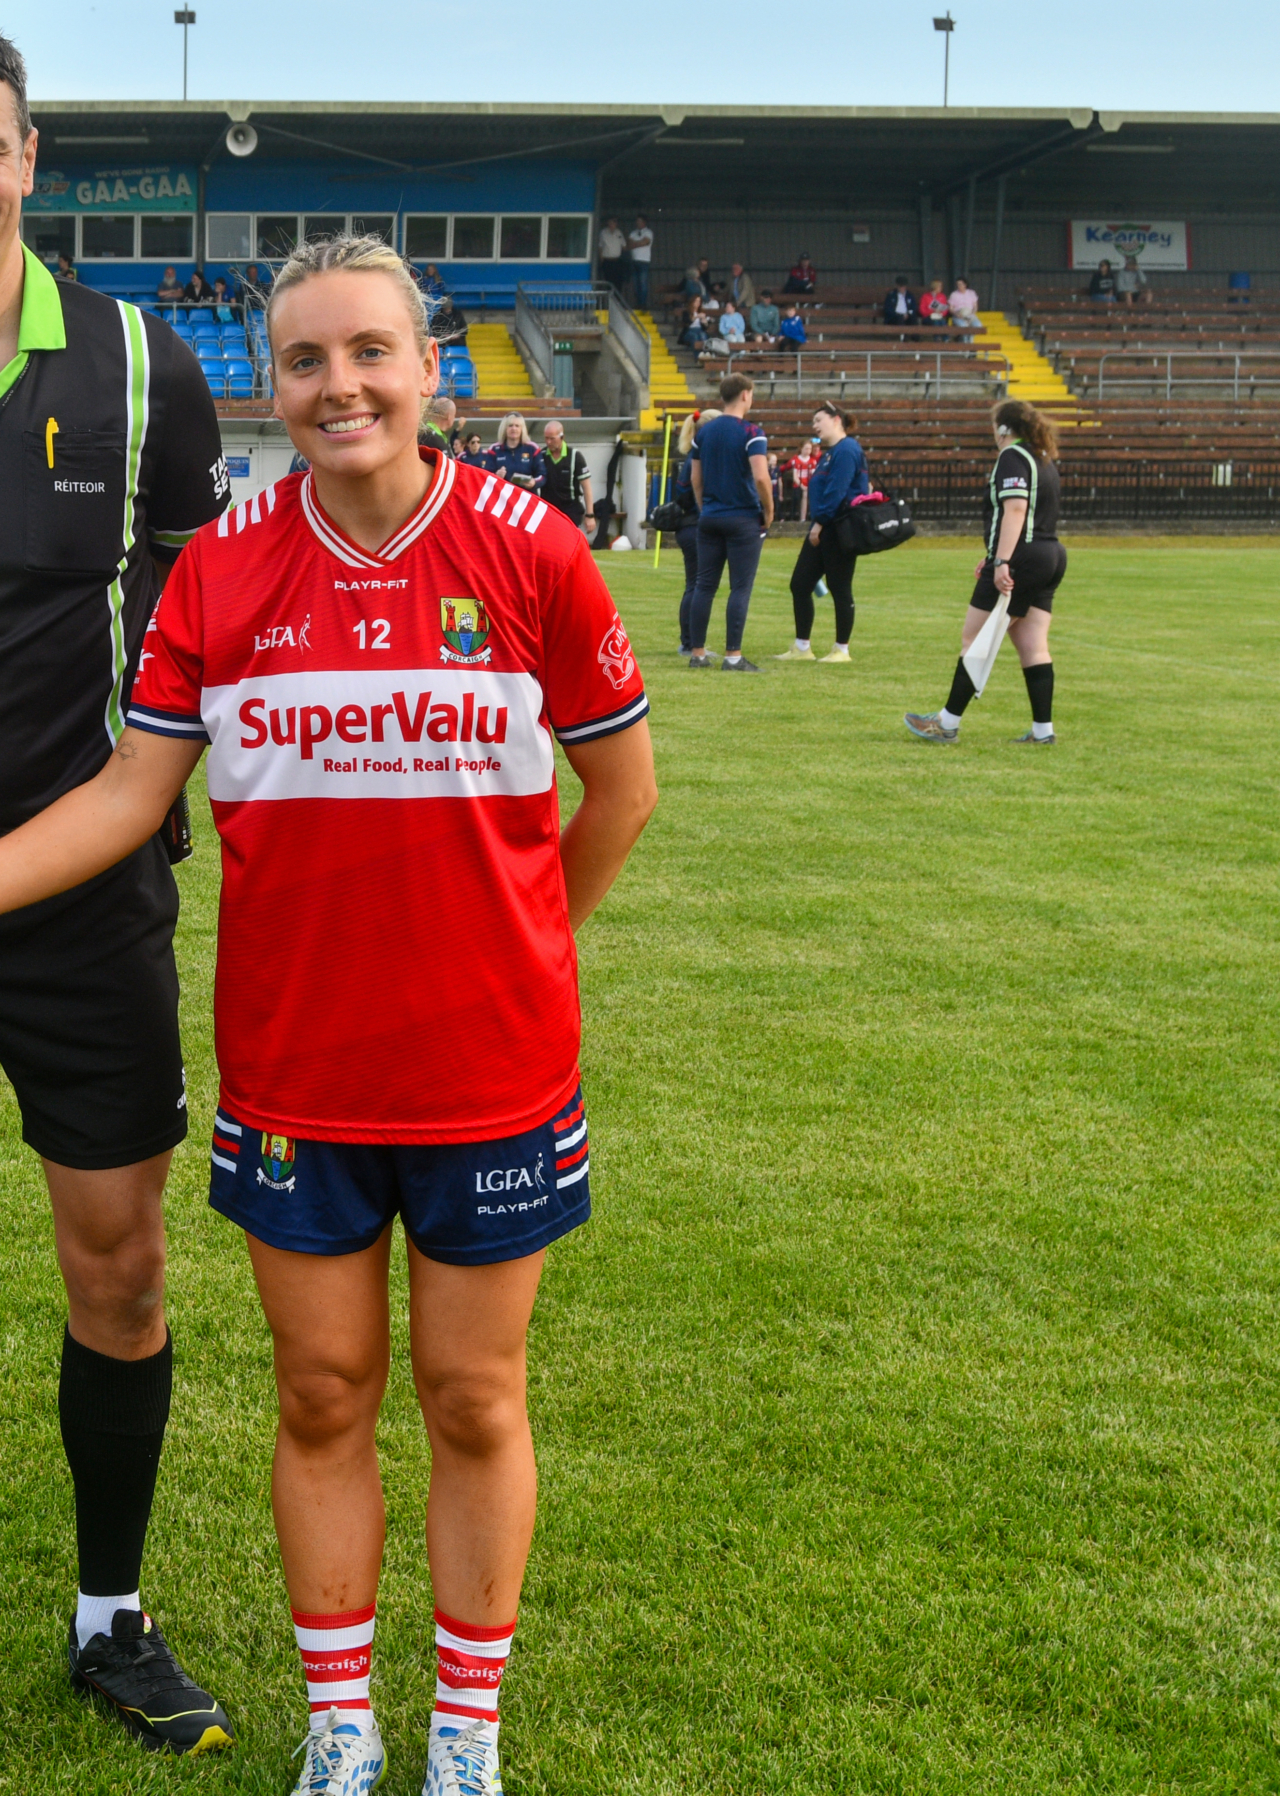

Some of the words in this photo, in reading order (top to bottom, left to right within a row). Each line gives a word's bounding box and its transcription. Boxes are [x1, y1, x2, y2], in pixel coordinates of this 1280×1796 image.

[76, 173, 192, 205] GAA-GAA
[1086, 226, 1171, 247] Kearney
[54, 478, 106, 493] RÉITEOIR
[352, 618, 391, 650] 12
[238, 691, 508, 760] SuperValu
[323, 757, 358, 772] Real
[363, 757, 408, 774] Food,
[413, 757, 450, 772] Real
[455, 756, 502, 775] People
[476, 1167, 534, 1193] LGFA
